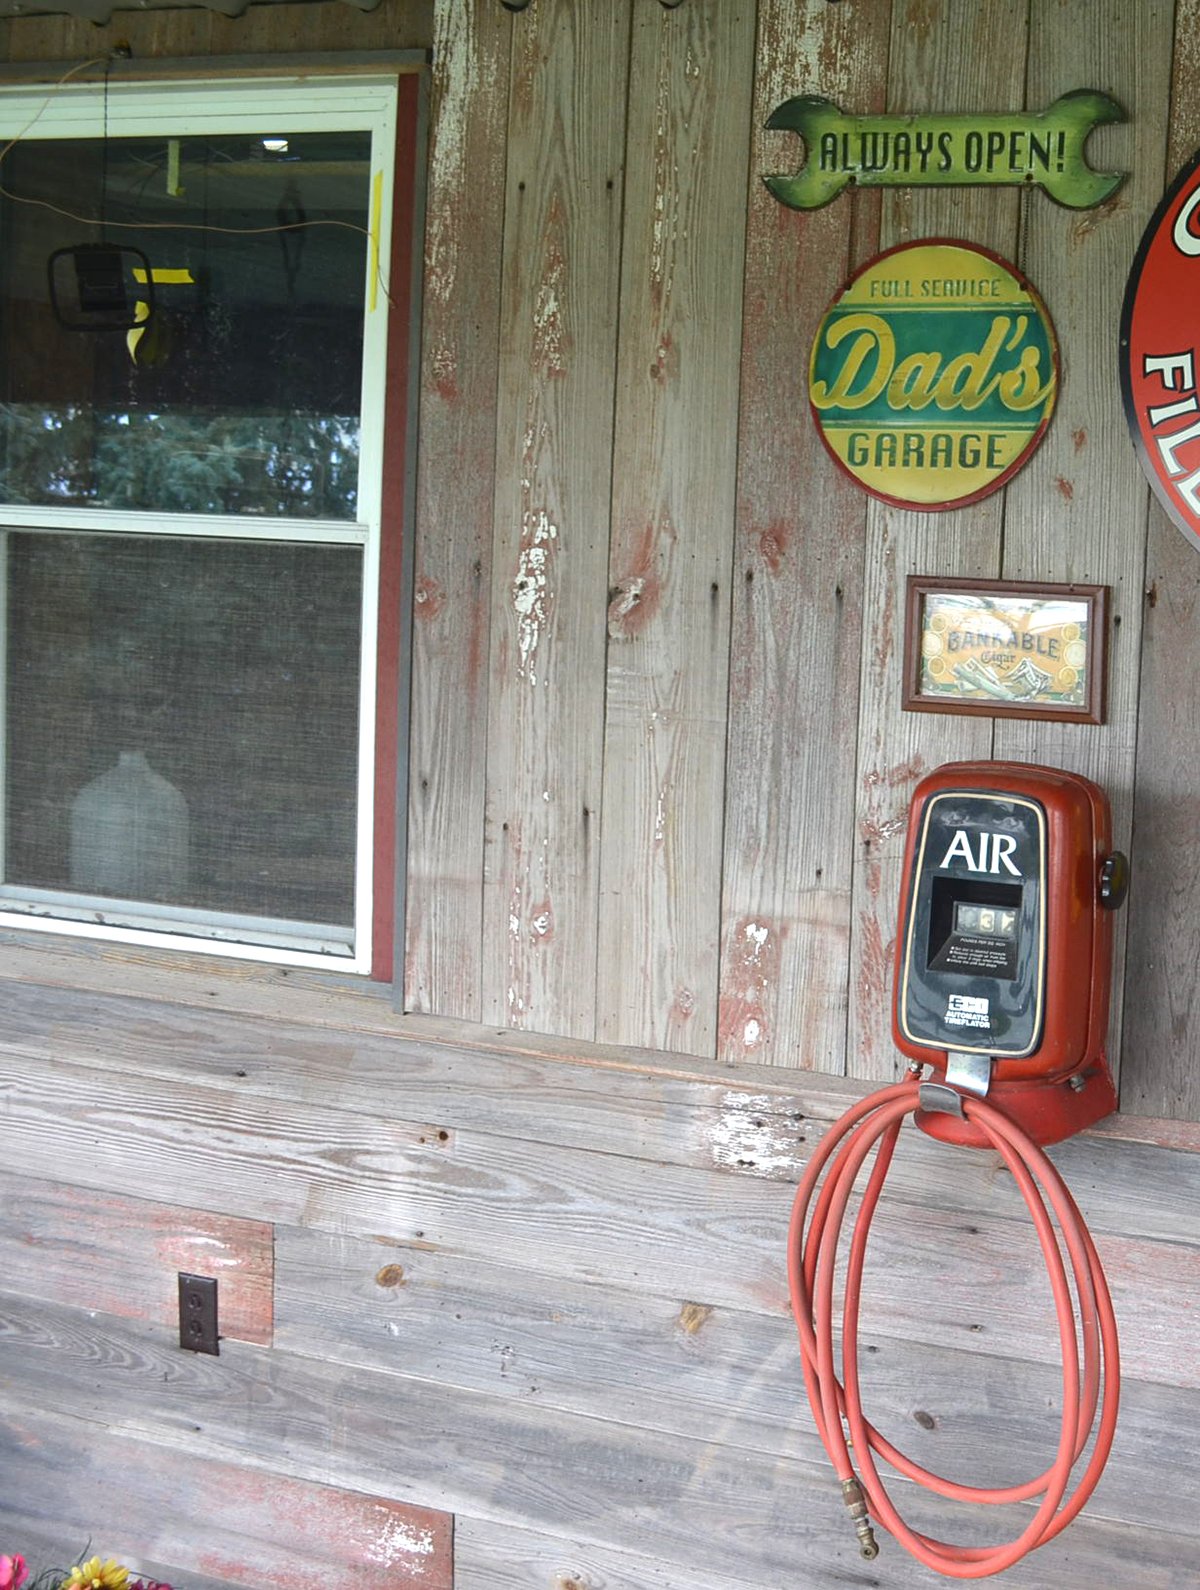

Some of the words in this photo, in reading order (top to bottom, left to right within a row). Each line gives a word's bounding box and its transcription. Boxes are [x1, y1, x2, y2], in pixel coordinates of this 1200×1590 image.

[819, 131, 953, 173] ALWAYS
[964, 131, 1066, 173] OPEN!
[870, 280, 913, 298] FULL
[921, 278, 1003, 298] SERVICE
[810, 313, 1056, 411] Dad's
[848, 432, 1007, 470] GARAGE
[940, 830, 1022, 877] AIR
[946, 1010, 989, 1022] AUTOMATIC
